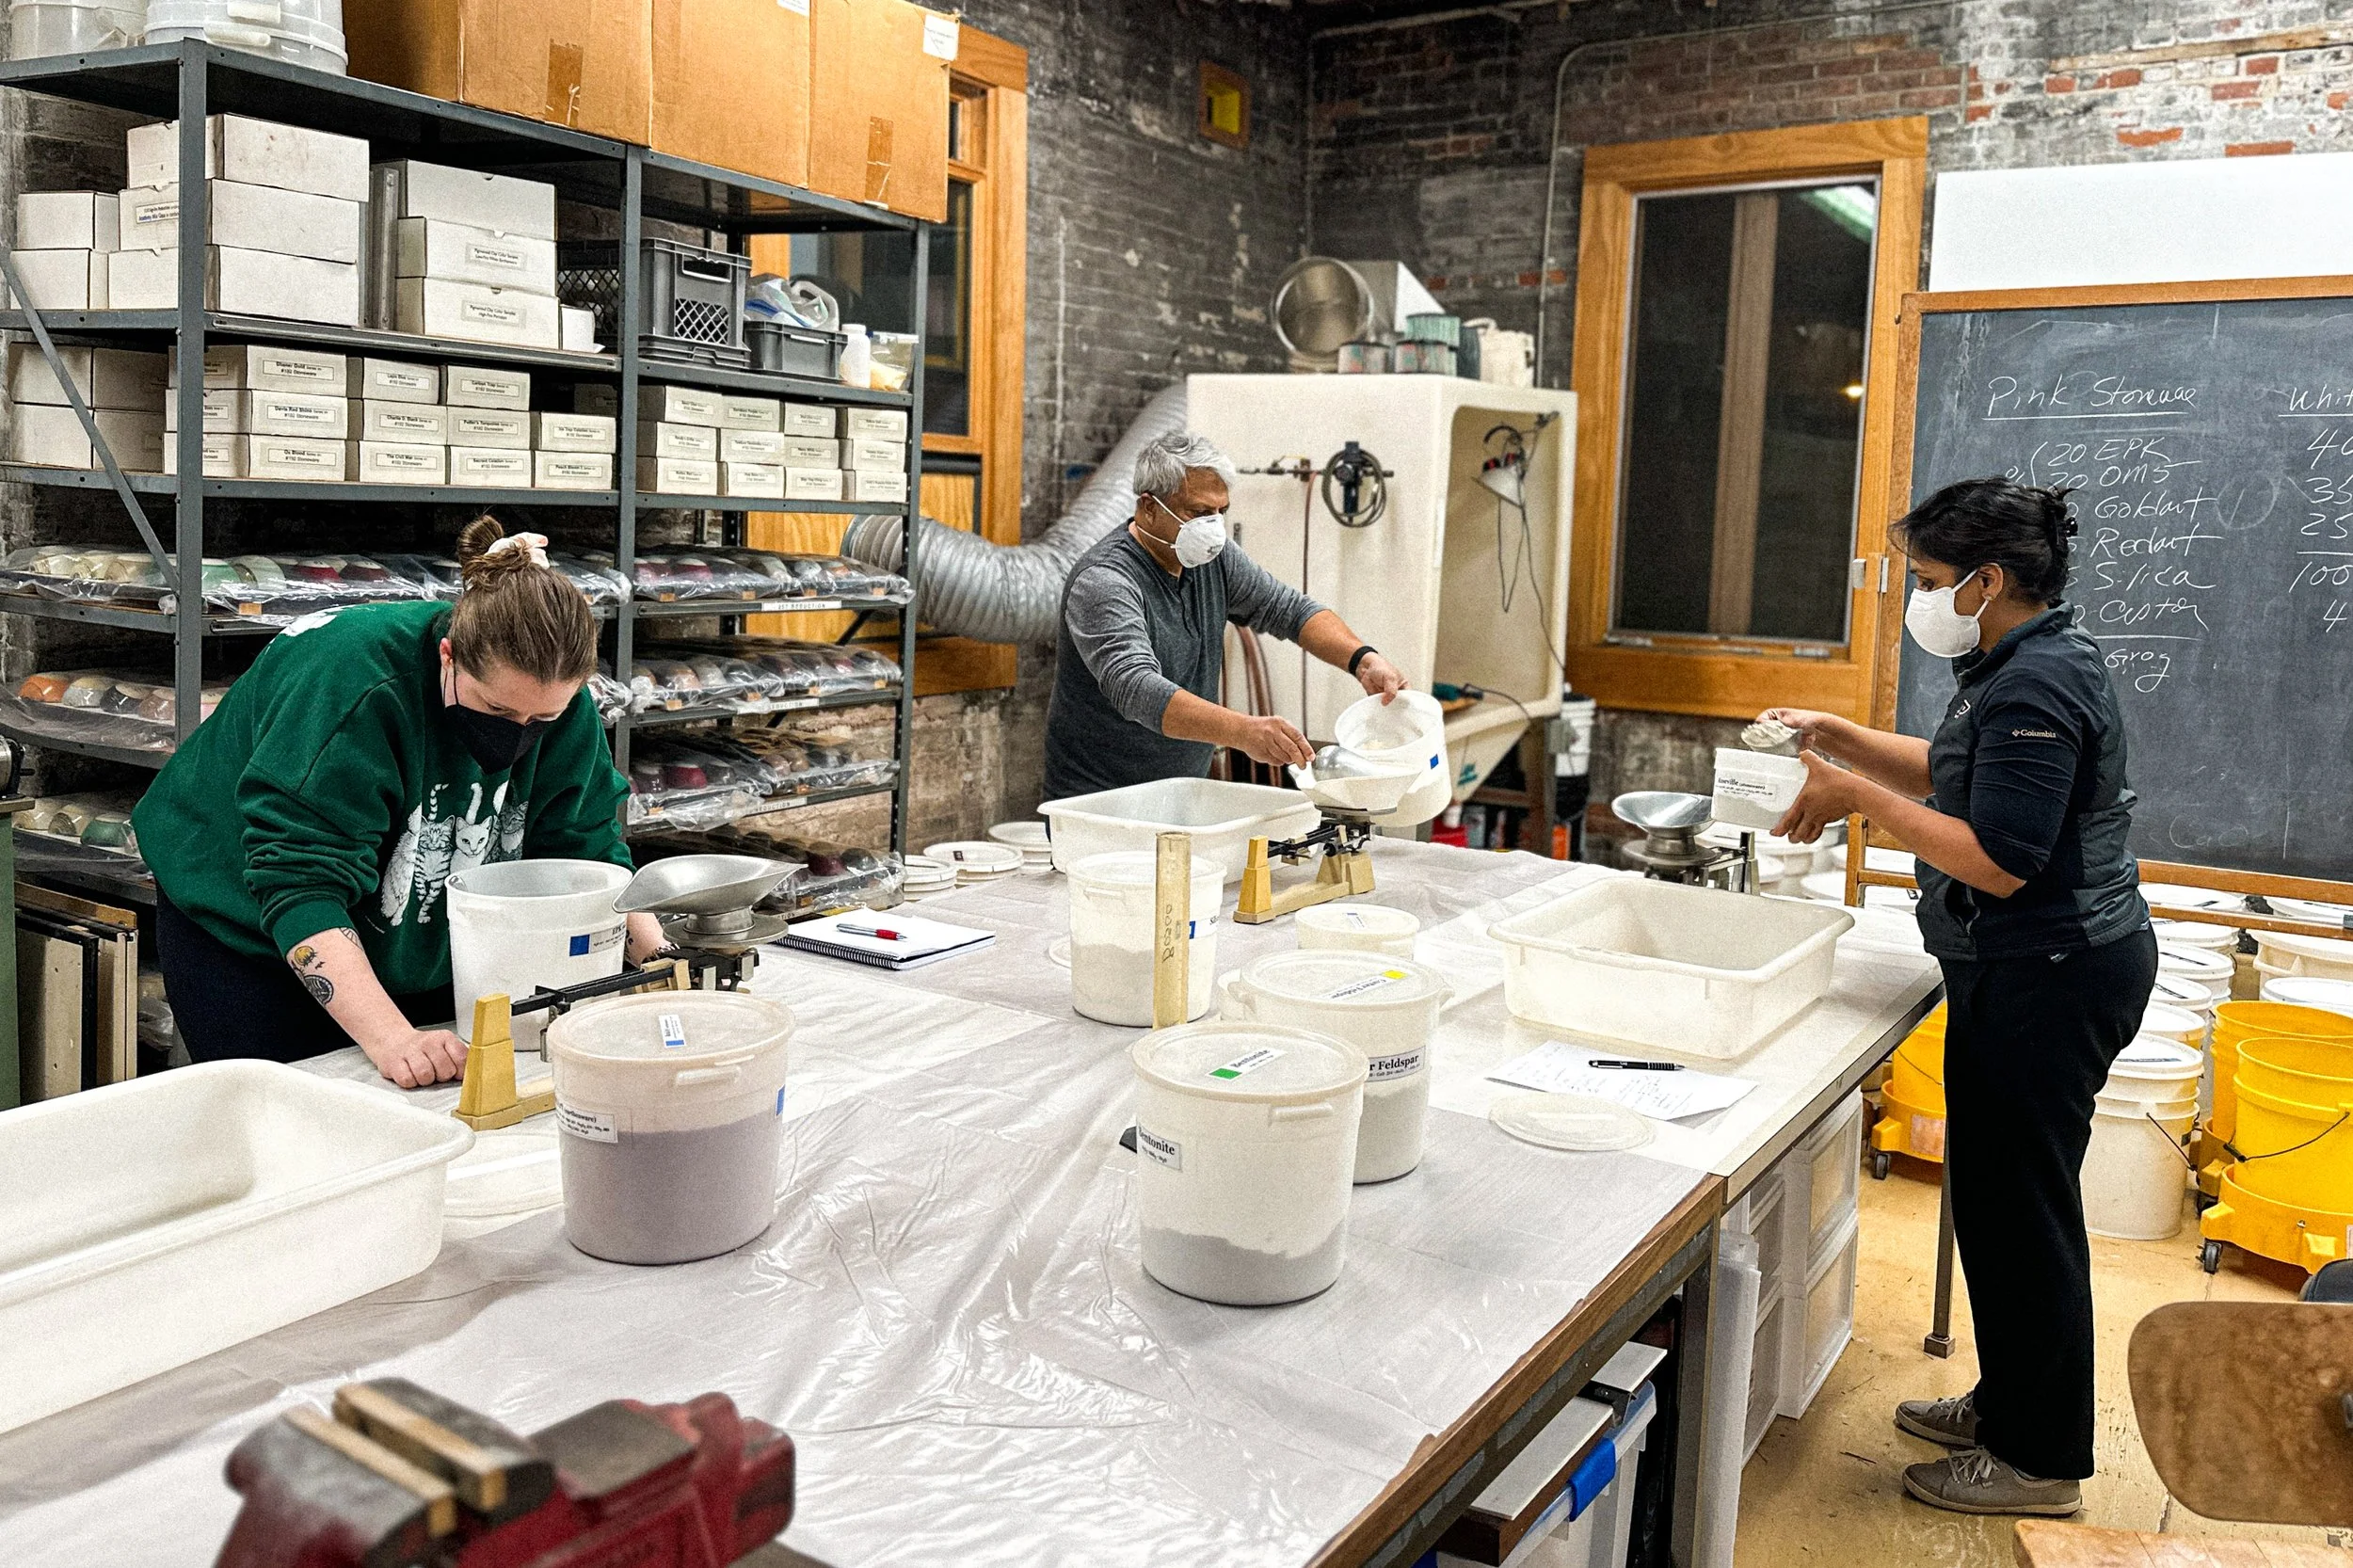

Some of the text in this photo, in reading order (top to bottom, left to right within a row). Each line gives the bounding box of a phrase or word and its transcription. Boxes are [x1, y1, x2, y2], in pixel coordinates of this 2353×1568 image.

[1988, 374, 2070, 416] Pink
[2094, 437, 2171, 462] EPK
[2090, 522, 2226, 558] Redart
[2105, 648, 2170, 693] Grog
[2020, 728, 2057, 739] Columbia
[1378, 1054, 1419, 1071] Feldspar
